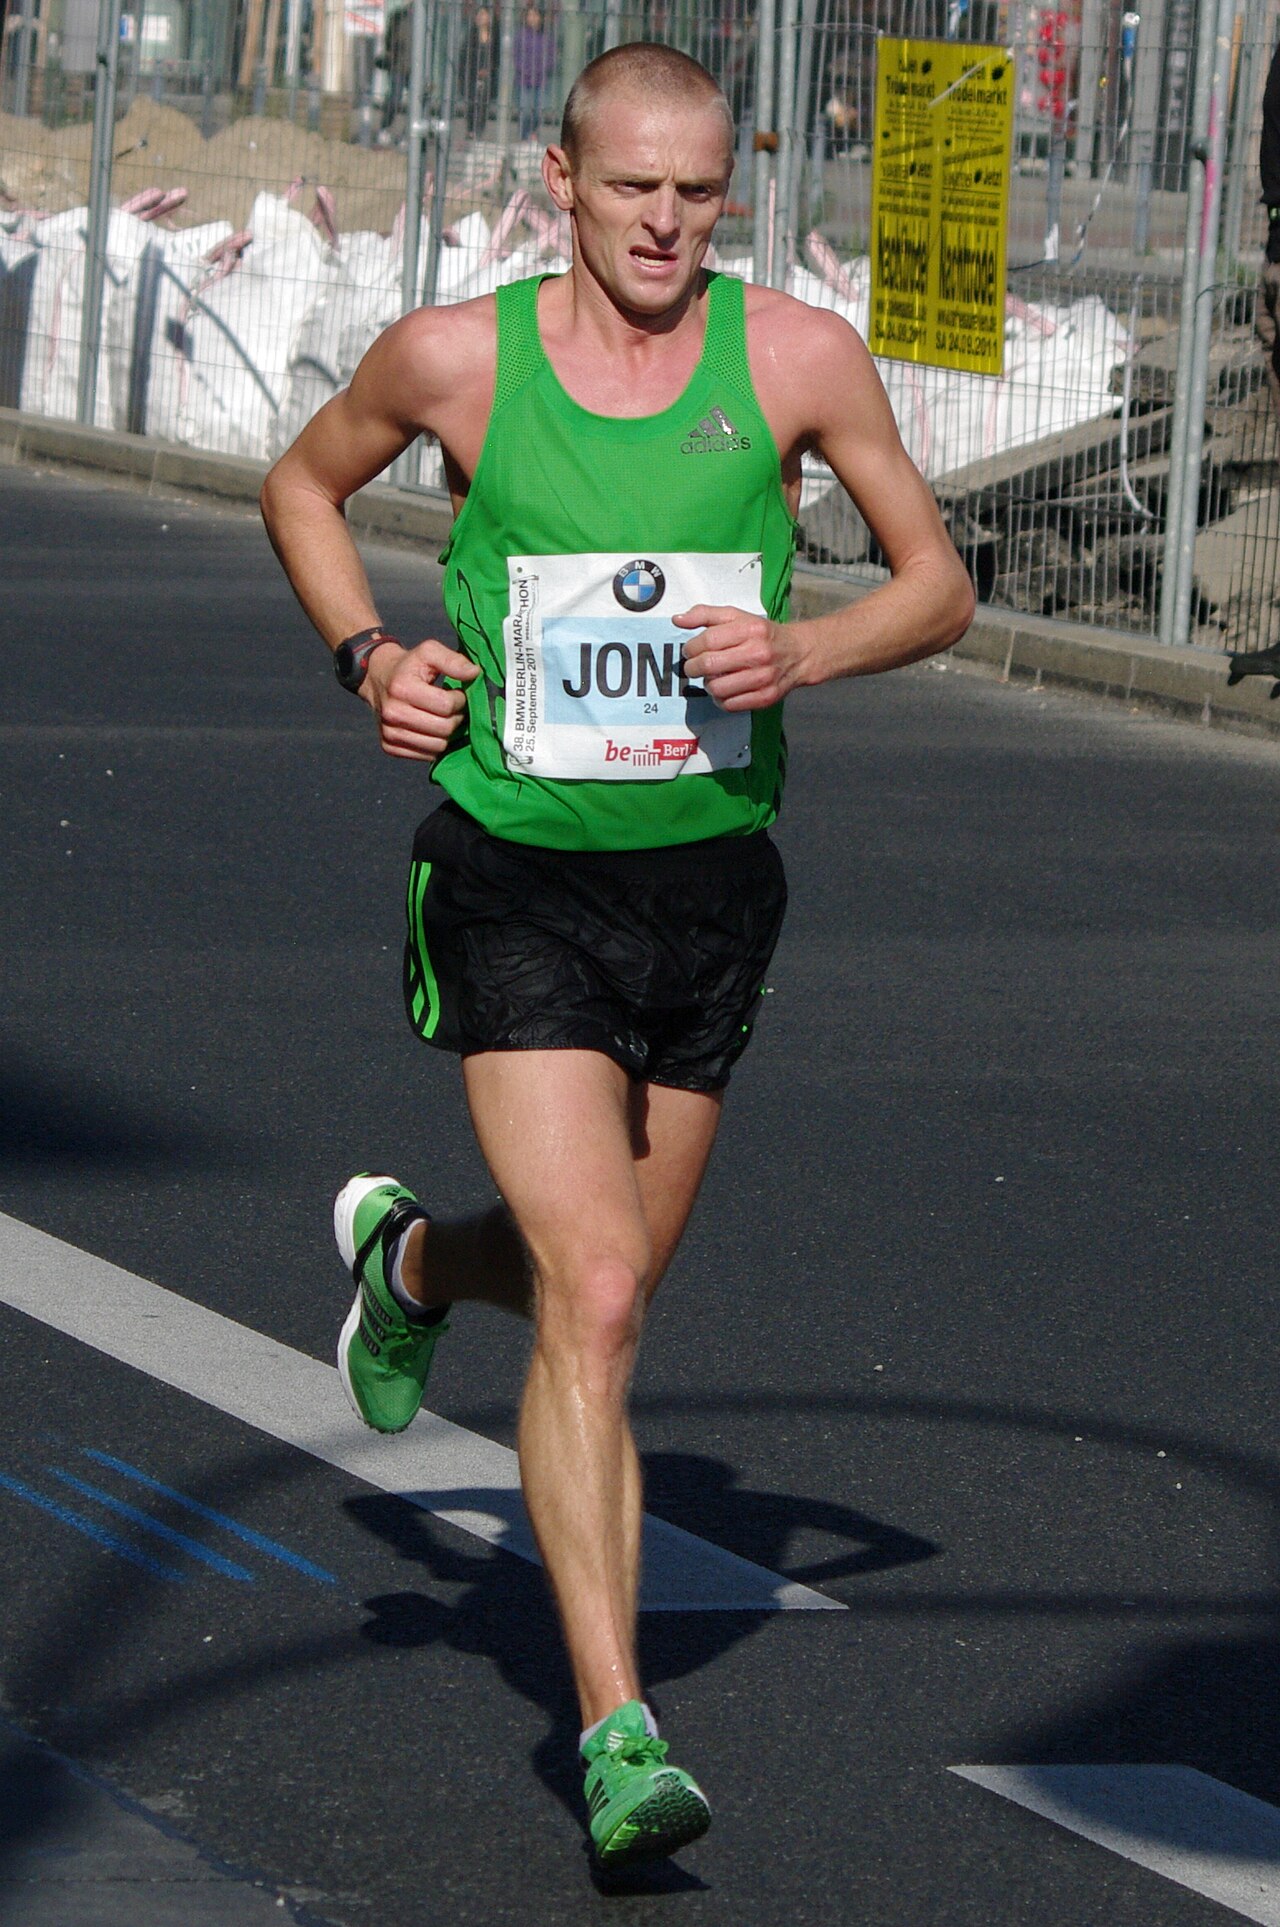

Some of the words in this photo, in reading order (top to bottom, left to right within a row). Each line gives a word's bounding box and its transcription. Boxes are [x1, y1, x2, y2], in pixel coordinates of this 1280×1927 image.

[935, 329, 946, 350] SA
[681, 435, 751, 454] adidas
[618, 561, 662, 578] BMW
[525, 647, 537, 671] 2011
[527, 672, 538, 734] September
[643, 703, 658, 714] 24
[515, 699, 525, 731] BMW
[513, 733, 524, 751] 38.
[525, 735, 536, 752] 25.
[604, 739, 632, 762] be
